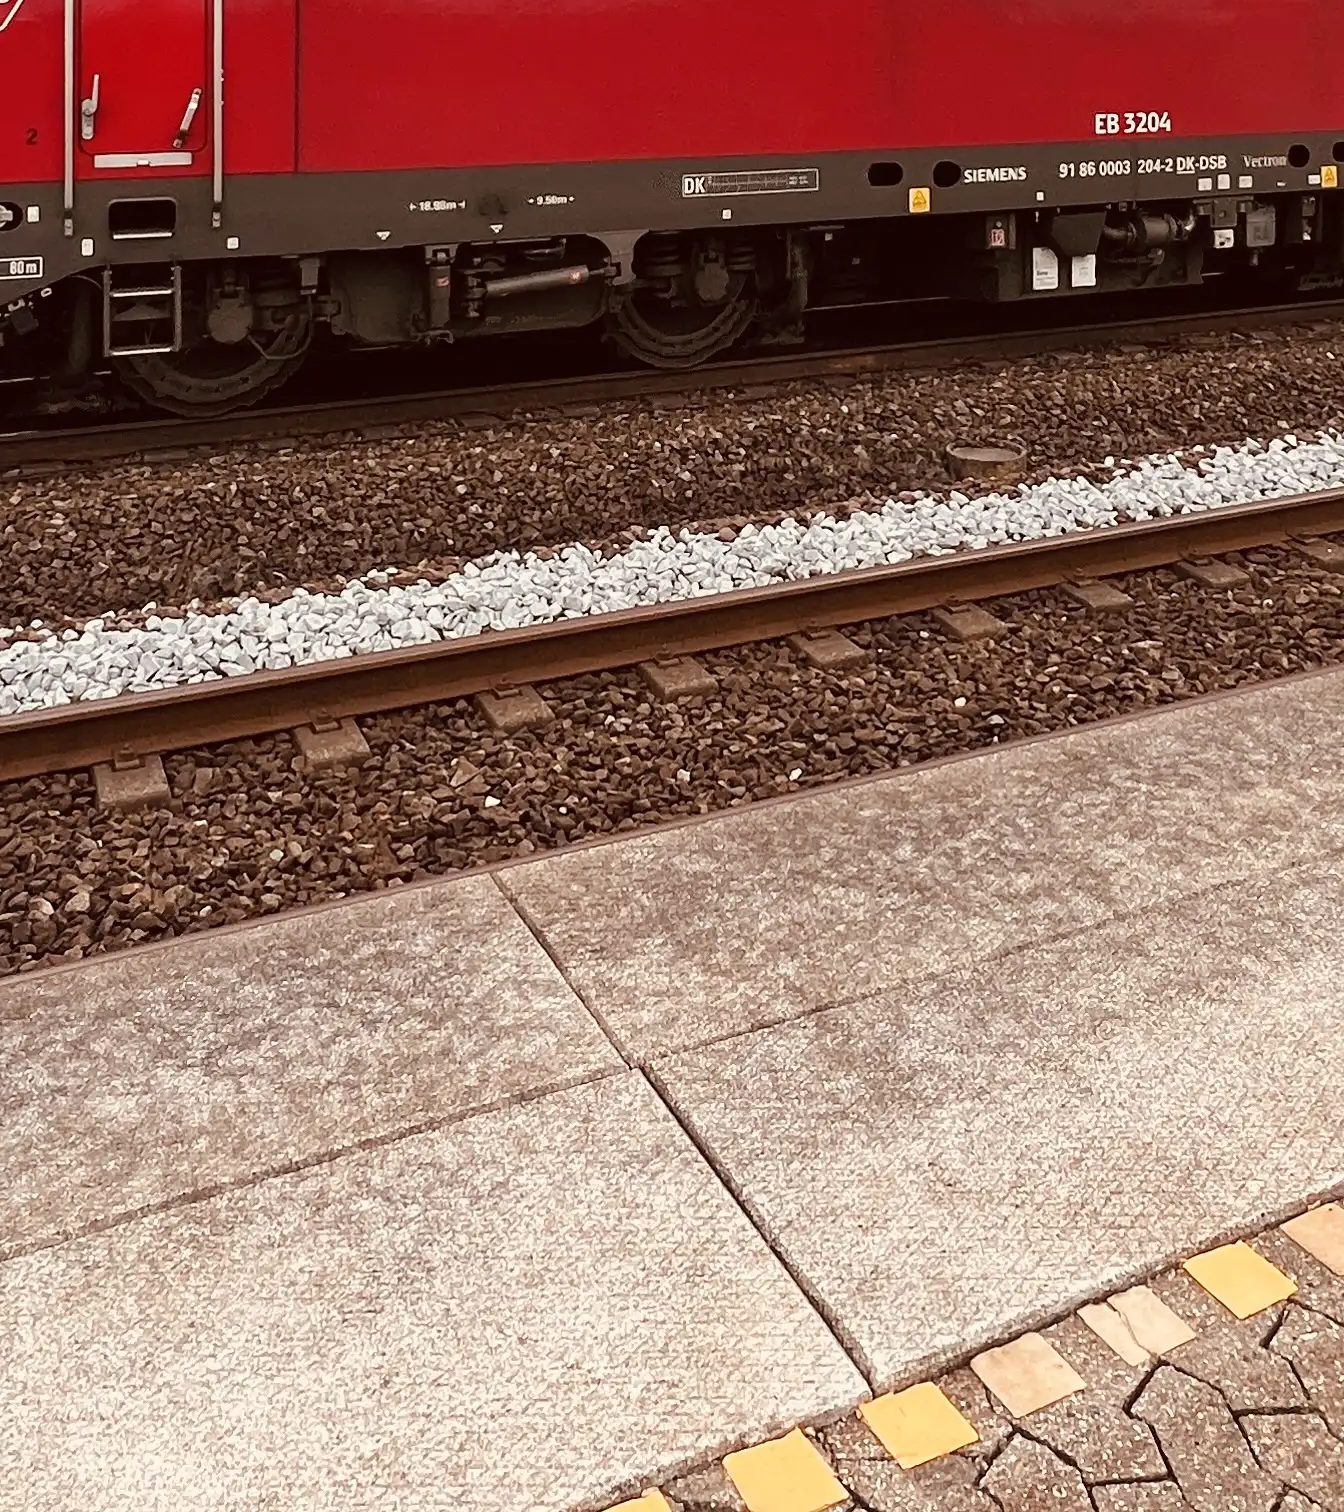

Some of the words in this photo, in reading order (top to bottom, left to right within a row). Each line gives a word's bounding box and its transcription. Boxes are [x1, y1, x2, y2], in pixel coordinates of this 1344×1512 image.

[1094, 113, 1120, 135] EB
[1123, 112, 1172, 134] 3204
[25, 127, 38, 146] 2
[1059, 162, 1075, 178] 91
[1079, 161, 1096, 177] 86
[1098, 159, 1131, 176] 0003
[1137, 158, 1174, 174] 204-2
[1176, 154, 1228, 174] DK-DSB
[1242, 154, 1287, 168] Vectron
[963, 166, 1028, 184] SIEMENS
[684, 177, 706, 194] DK
